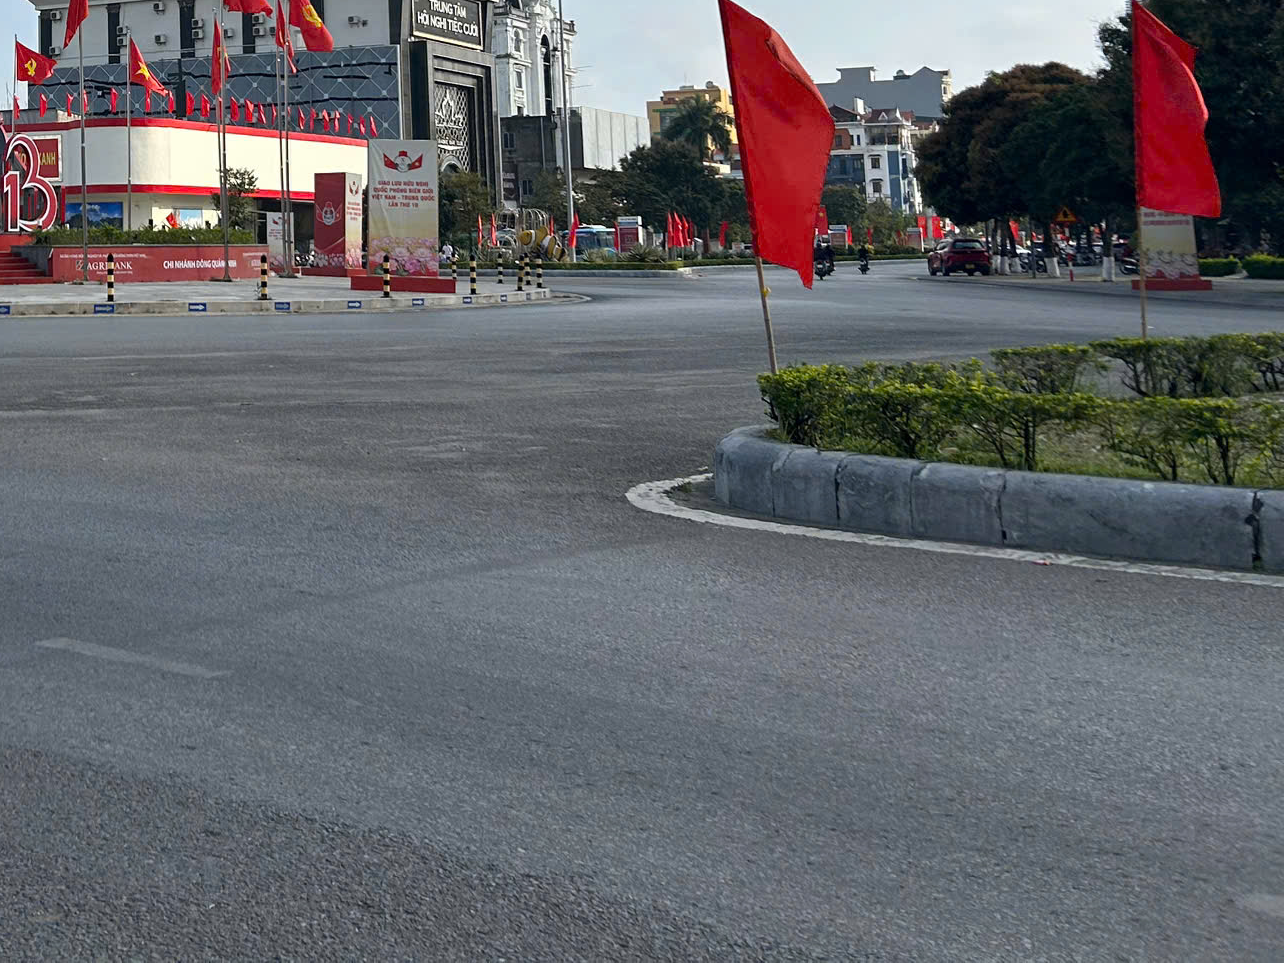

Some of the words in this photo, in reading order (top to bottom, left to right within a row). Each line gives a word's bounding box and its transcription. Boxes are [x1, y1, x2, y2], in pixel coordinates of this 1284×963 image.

[453, 2, 467, 18] TÂM
[417, 9, 430, 28] HỘI
[430, 14, 447, 33] NGHỊ
[447, 17, 463, 35] TIỆC
[87, 261, 133, 270] AGRIANK
[163, 260, 174, 269] CHI
[175, 258, 196, 269] NHÁNH
[196, 258, 212, 268] ĐÔNG
[212, 257, 226, 268] QUẢN
